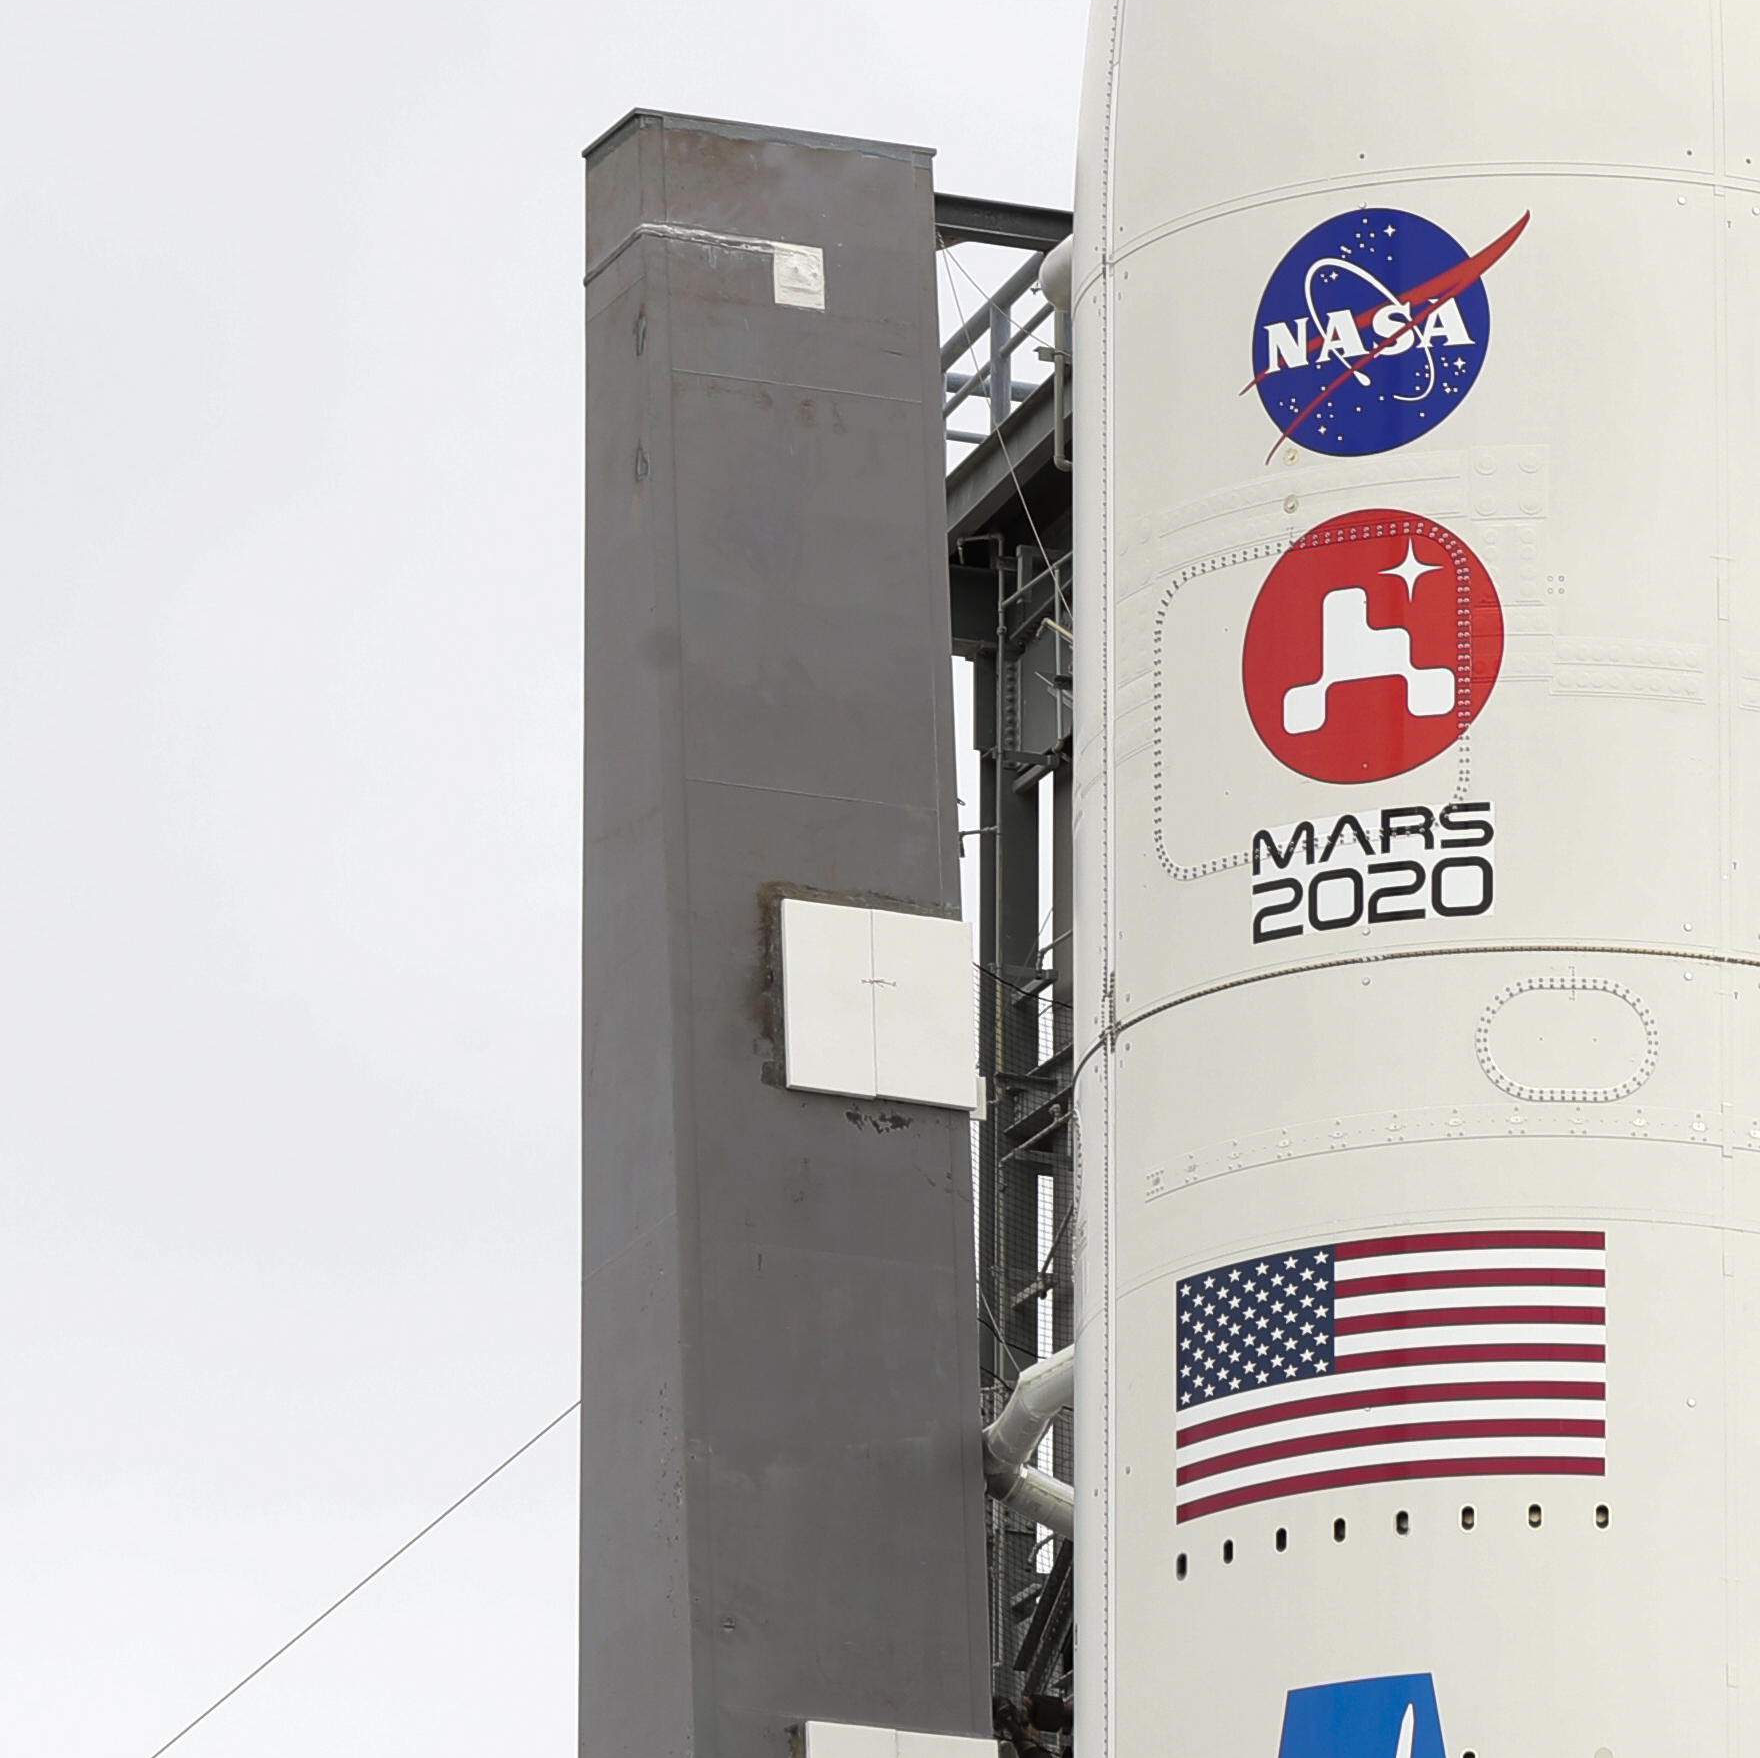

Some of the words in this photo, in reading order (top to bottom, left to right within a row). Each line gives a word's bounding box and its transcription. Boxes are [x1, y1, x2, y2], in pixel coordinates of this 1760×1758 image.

[1263, 297, 1477, 375] NASA
[1252, 802, 1494, 876] MARS
[1252, 856, 1494, 945] 2020
